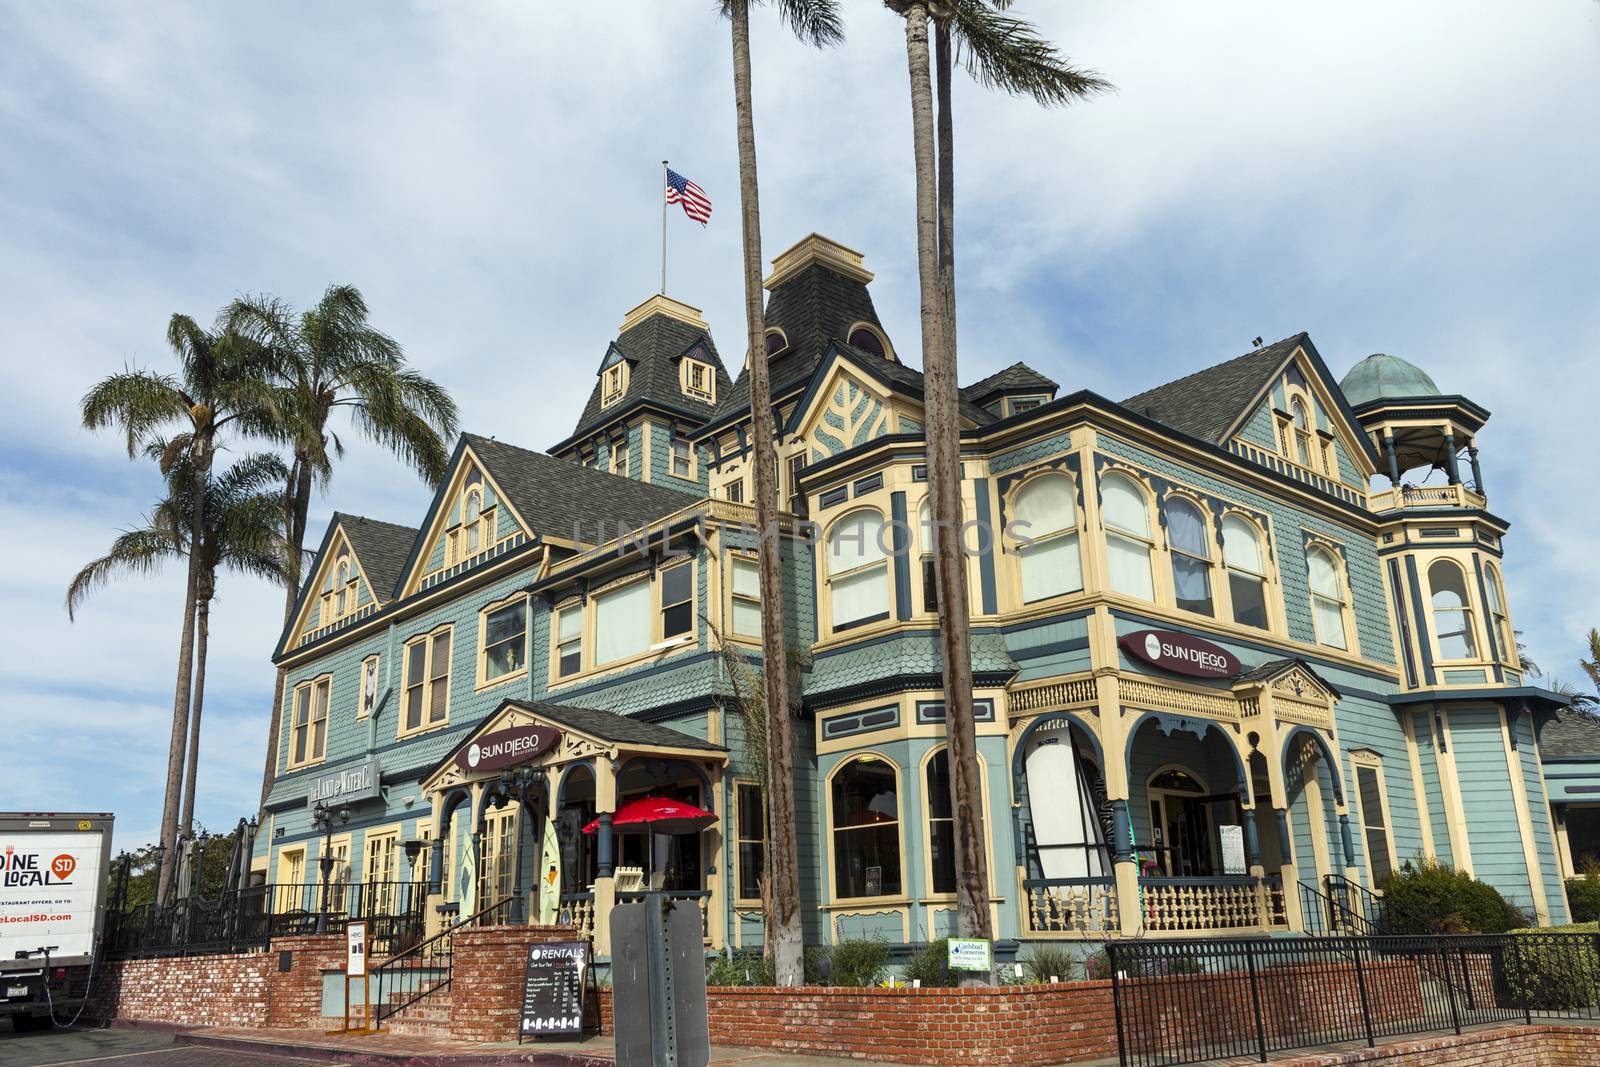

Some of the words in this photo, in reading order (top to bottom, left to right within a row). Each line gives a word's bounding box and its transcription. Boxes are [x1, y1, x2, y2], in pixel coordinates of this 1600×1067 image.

[1162, 643, 1189, 660] SUN
[1190, 649, 1227, 669] DIEGO
[481, 742, 503, 759] SUN
[504, 734, 539, 757] DIEGO
[318, 778, 334, 800] LAND
[341, 771, 361, 795] WATER
[55, 859, 73, 871] SD
[541, 948, 584, 960] RENTALS
